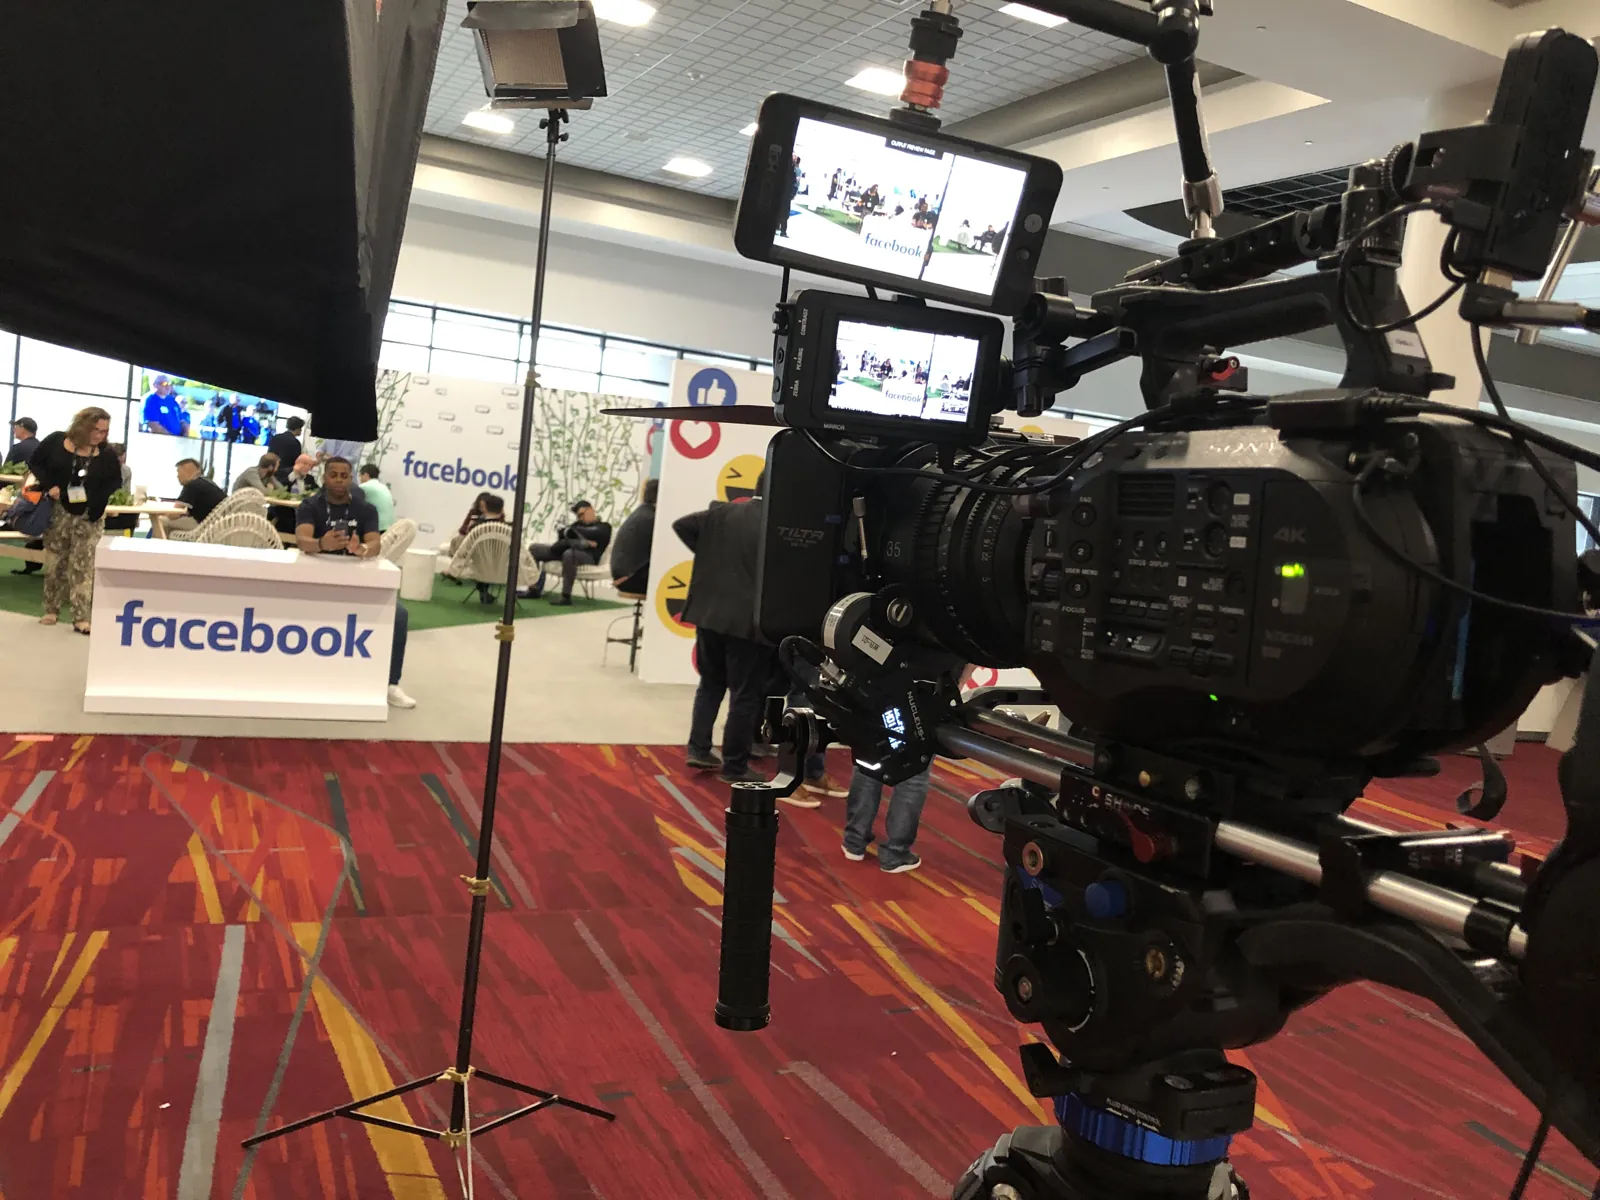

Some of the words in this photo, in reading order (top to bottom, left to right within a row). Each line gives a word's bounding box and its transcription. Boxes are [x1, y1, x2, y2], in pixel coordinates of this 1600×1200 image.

[865, 232, 922, 257] facebook
[403, 450, 518, 491] facebook
[777, 526, 825, 540] TILTA
[1273, 526, 1306, 544] 4K
[886, 540, 901, 557] 35
[1061, 605, 1087, 614] FOCUS
[115, 599, 374, 658] facebook
